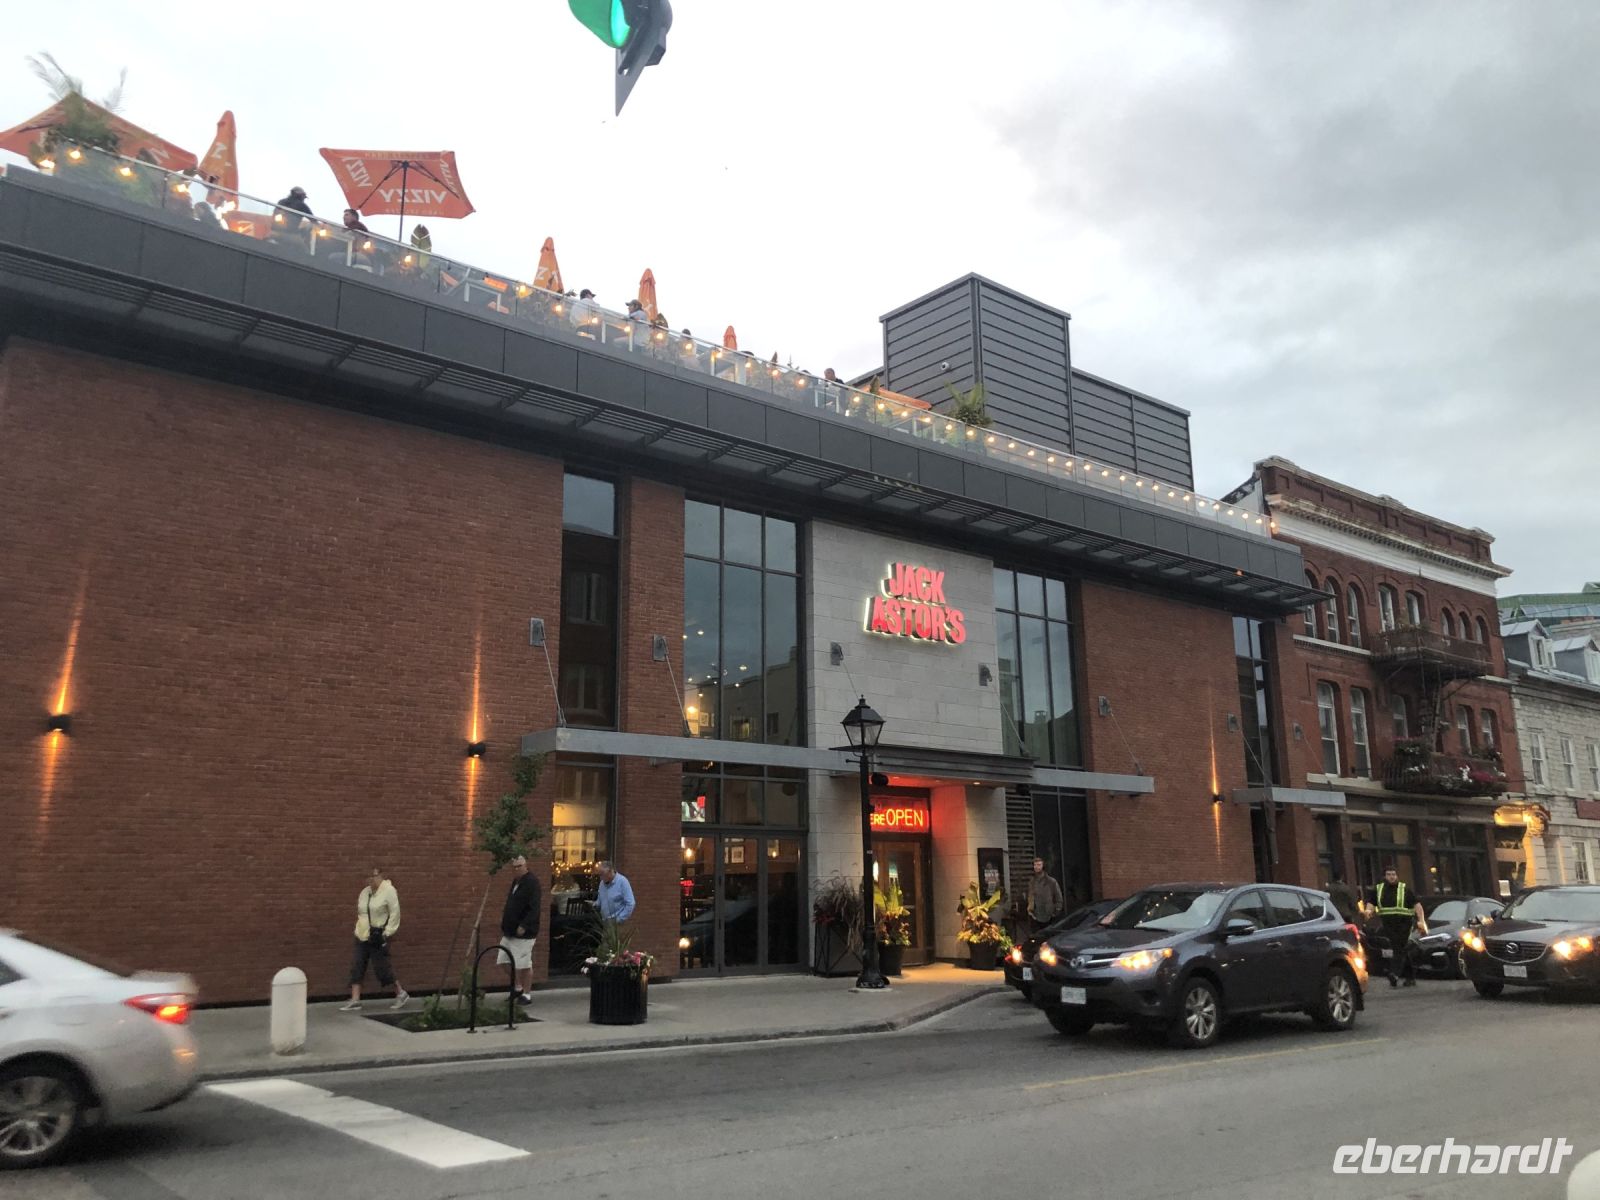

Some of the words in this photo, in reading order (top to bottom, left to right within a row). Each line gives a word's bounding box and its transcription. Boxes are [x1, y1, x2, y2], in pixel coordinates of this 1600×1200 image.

[887, 562, 945, 603] JACK
[869, 596, 966, 644] ASTOR'S
[886, 808, 924, 827] OPEN
